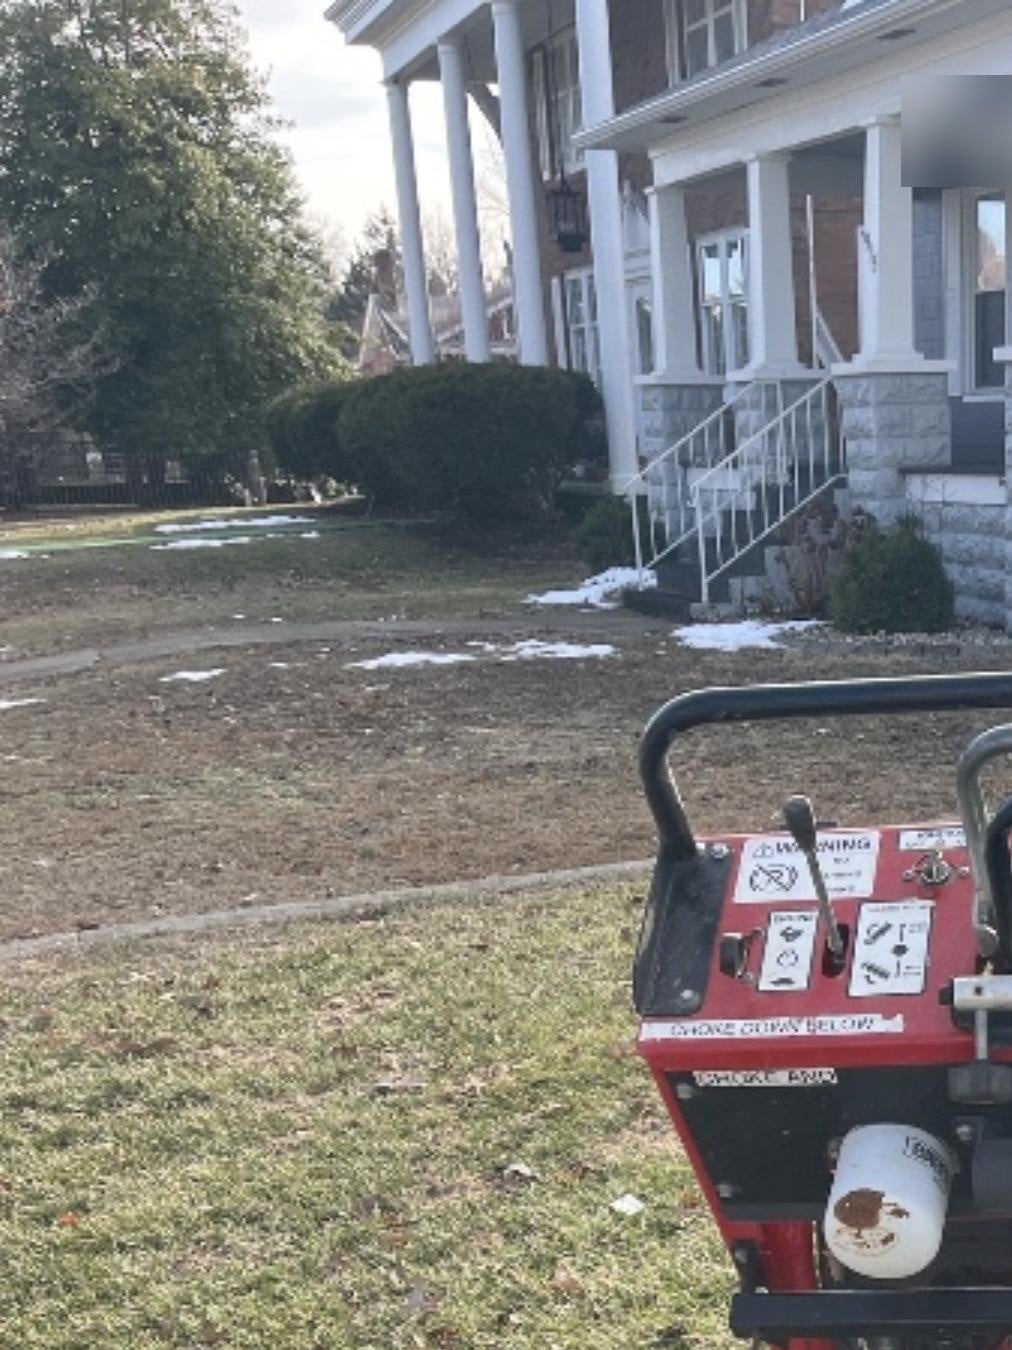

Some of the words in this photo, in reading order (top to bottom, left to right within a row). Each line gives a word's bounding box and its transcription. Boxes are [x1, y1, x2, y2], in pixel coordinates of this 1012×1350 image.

[671, 1022, 736, 1036] CHOKE
[740, 1018, 799, 1034] DOWN
[806, 1015, 875, 1032] BELOW
